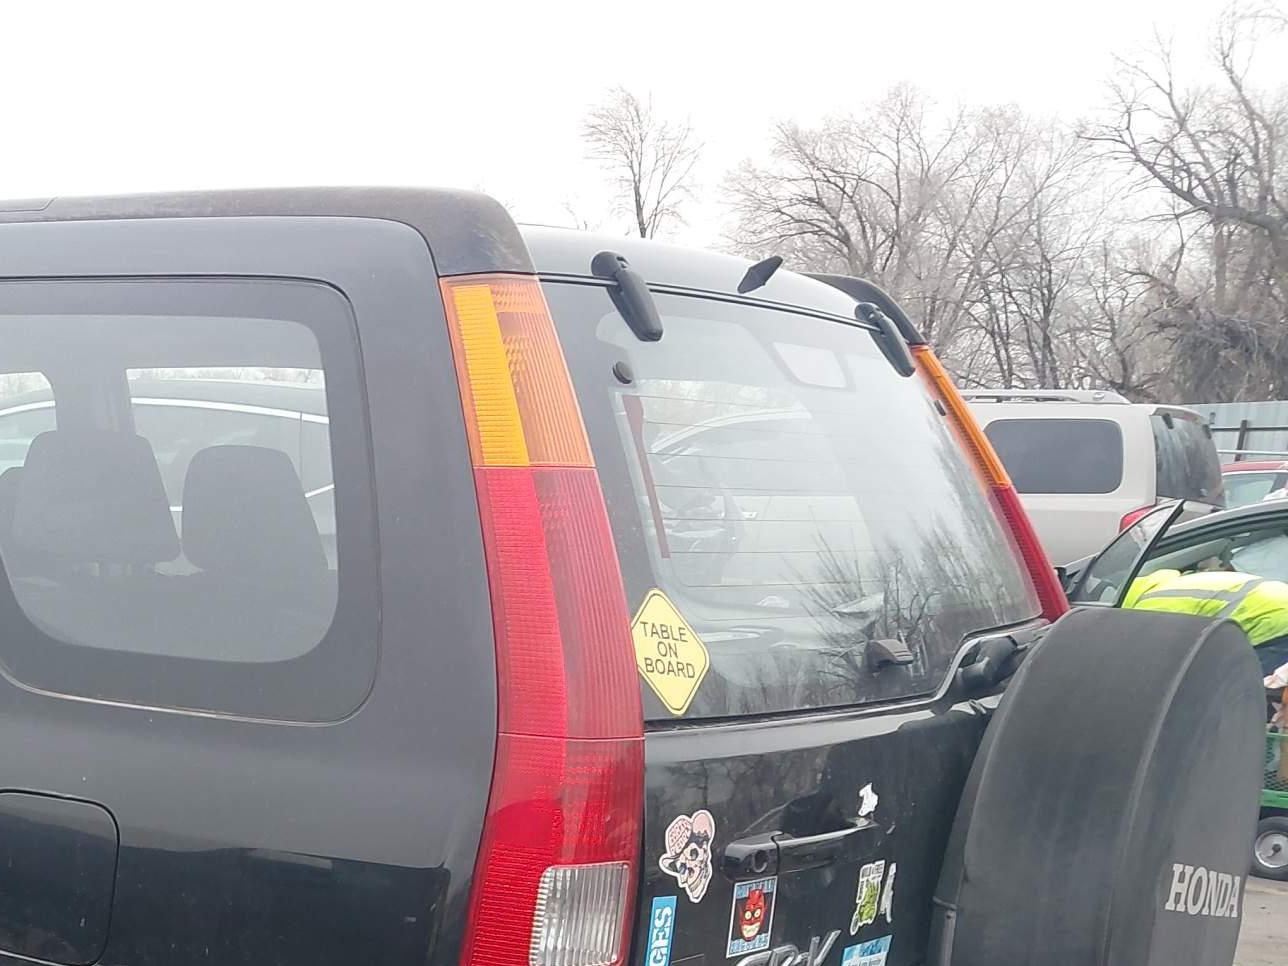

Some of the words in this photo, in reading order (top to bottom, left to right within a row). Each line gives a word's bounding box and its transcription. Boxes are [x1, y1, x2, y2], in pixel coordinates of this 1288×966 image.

[639, 621, 688, 642] TABLE
[657, 641, 678, 659] ON
[644, 657, 696, 679] BOARD
[1164, 863, 1241, 918] HONDA
